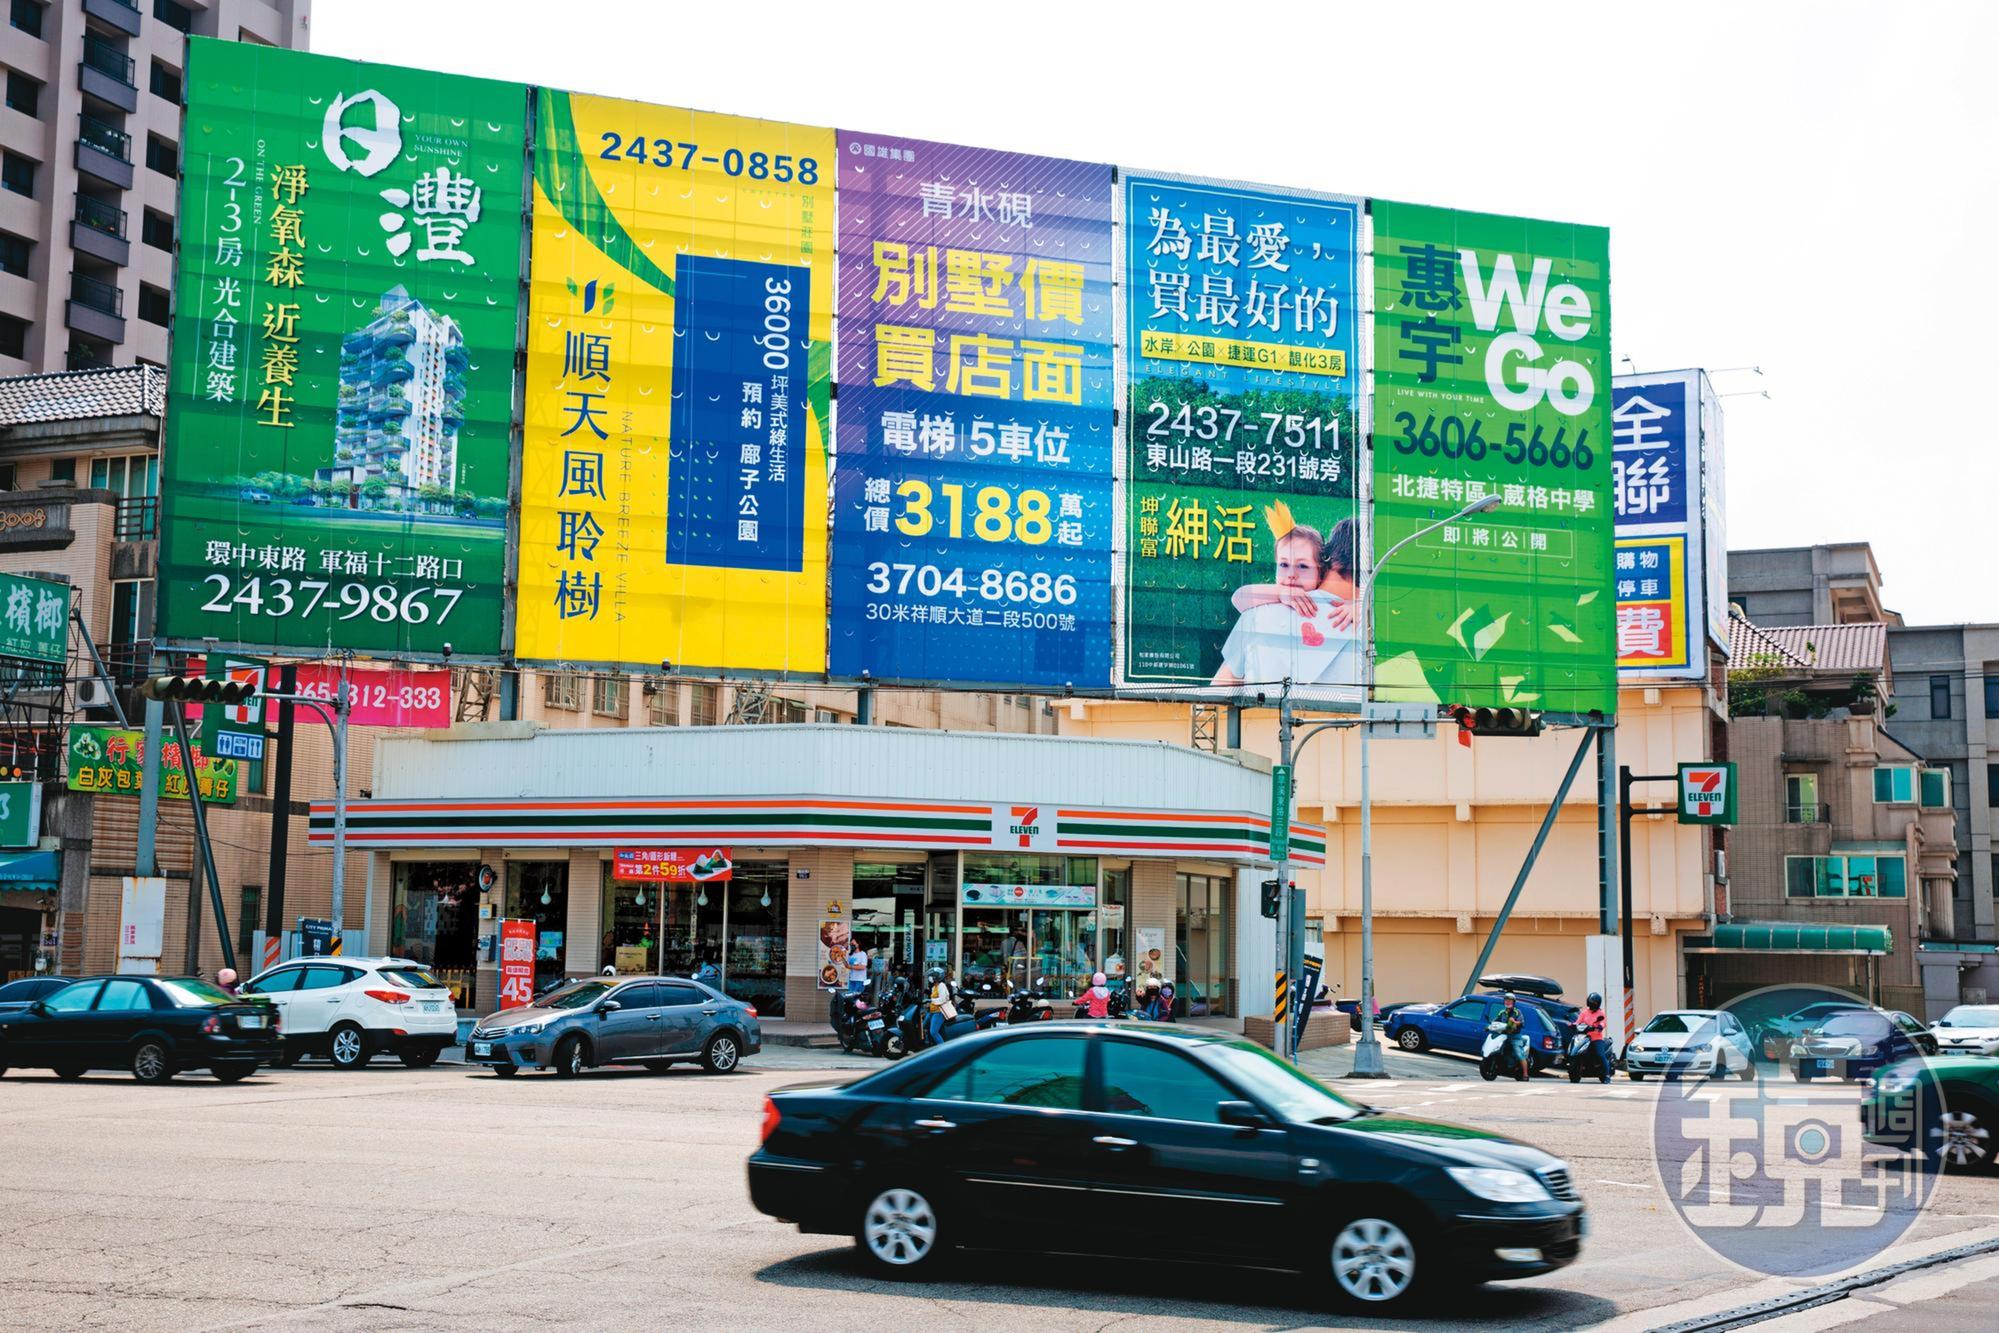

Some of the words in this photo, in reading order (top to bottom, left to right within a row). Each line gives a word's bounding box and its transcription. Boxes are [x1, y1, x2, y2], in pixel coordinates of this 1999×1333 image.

[257, 139, 265, 156] ON
[414, 144, 463, 157] SUNSHINE
[415, 134, 441, 145] YOUR
[445, 139, 468, 147] OWN
[600, 131, 819, 185] 2437-0858
[863, 144, 915, 162] 國雄集團
[256, 159, 265, 177] THE
[215, 157, 247, 267] 2-3房
[253, 178, 263, 225] GREEN
[265, 163, 309, 289] 淨氧森
[919, 182, 1033, 229] 青水硯
[871, 240, 1085, 325] 別墅價
[1149, 269, 1339, 338] 買最好的
[1457, 248, 1592, 342] We
[206, 277, 241, 403] 光合建築
[1399, 243, 1463, 384] 惠宇
[256, 303, 301, 428] 近養生
[873, 323, 1085, 406] 買店面
[1145, 364, 1228, 379] ELEGANT
[1244, 375, 1342, 391] LIFESTYLE
[1484, 331, 1595, 416] Go
[741, 382, 763, 429] 預約
[1397, 388, 1414, 397] LIVE
[1417, 390, 1438, 399] WITH
[1441, 392, 1463, 401] YOUR
[1466, 395, 1485, 404] TIME
[618, 410, 633, 483] NATURE
[881, 410, 955, 456] 電梯
[969, 420, 1070, 464] 5車位
[1148, 402, 1340, 450] 2437-7511
[1393, 411, 1594, 470] 3606-5666
[553, 331, 612, 621] 順天風聆樹
[1146, 442, 1341, 482] 東山路一段231號旁
[1613, 395, 1671, 515] 全聯
[864, 477, 891, 533] 總價
[895, 480, 1053, 545] 3188
[1058, 493, 1083, 546] 萬起
[1391, 474, 1487, 502] 北捷特區
[1503, 484, 1595, 512] 葳格中學
[615, 491, 631, 564] BREEZE
[1140, 496, 1159, 558] 坤聯富
[1165, 498, 1256, 563] 紳活
[205, 540, 305, 572] 環中東路
[319, 549, 463, 579] 軍福十二路口
[866, 561, 1077, 606] 3704-8686
[1616, 551, 1659, 570] 購物
[5, 584, 63, 640] 檳榔
[200, 573, 463, 626] 2437-9867
[614, 572, 627, 622] VILLA
[1618, 579, 1659, 598] 停車
[866, 603, 1076, 632] 30米祥順大道二段500號
[503, 977, 532, 1002] 45
